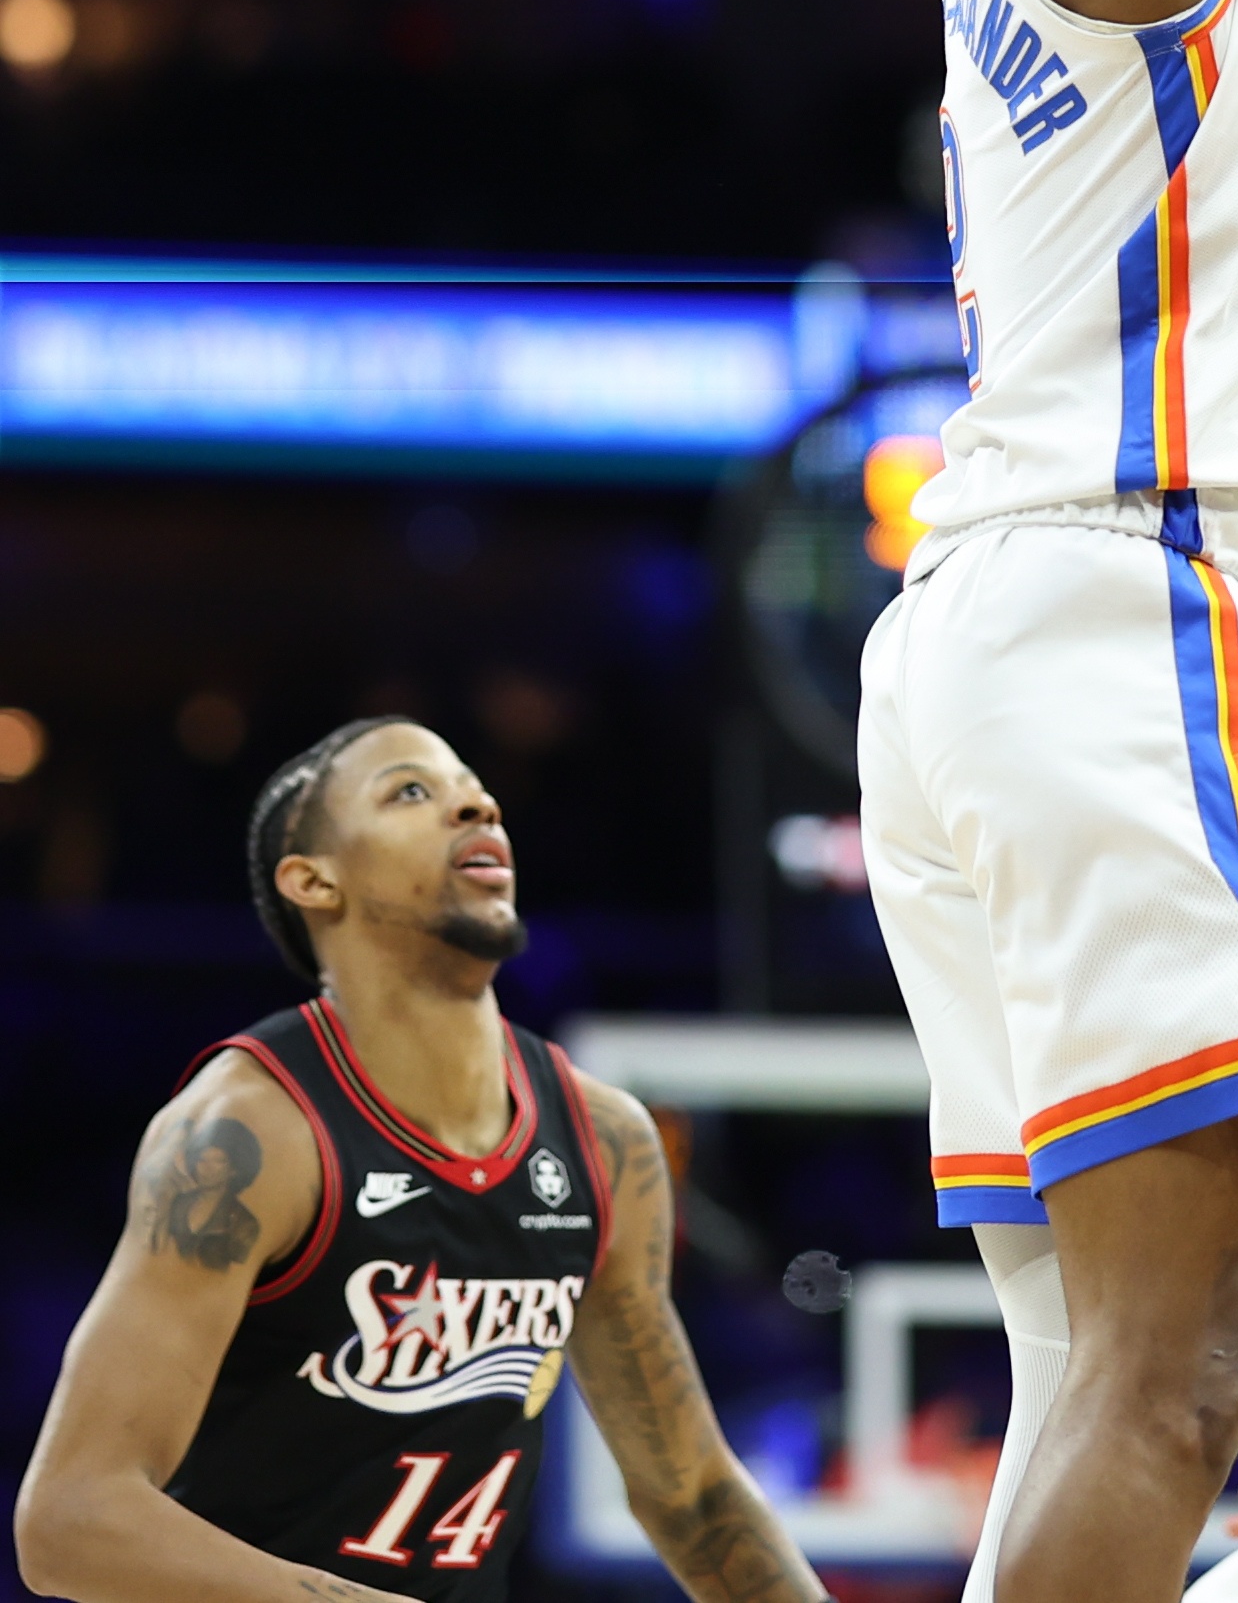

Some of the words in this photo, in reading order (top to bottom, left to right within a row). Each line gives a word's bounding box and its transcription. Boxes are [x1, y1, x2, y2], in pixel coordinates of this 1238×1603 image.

[364, 1171, 413, 1200] NIKE
[518, 1213, 593, 1231] crypto.com
[337, 1448, 523, 1569] 14
